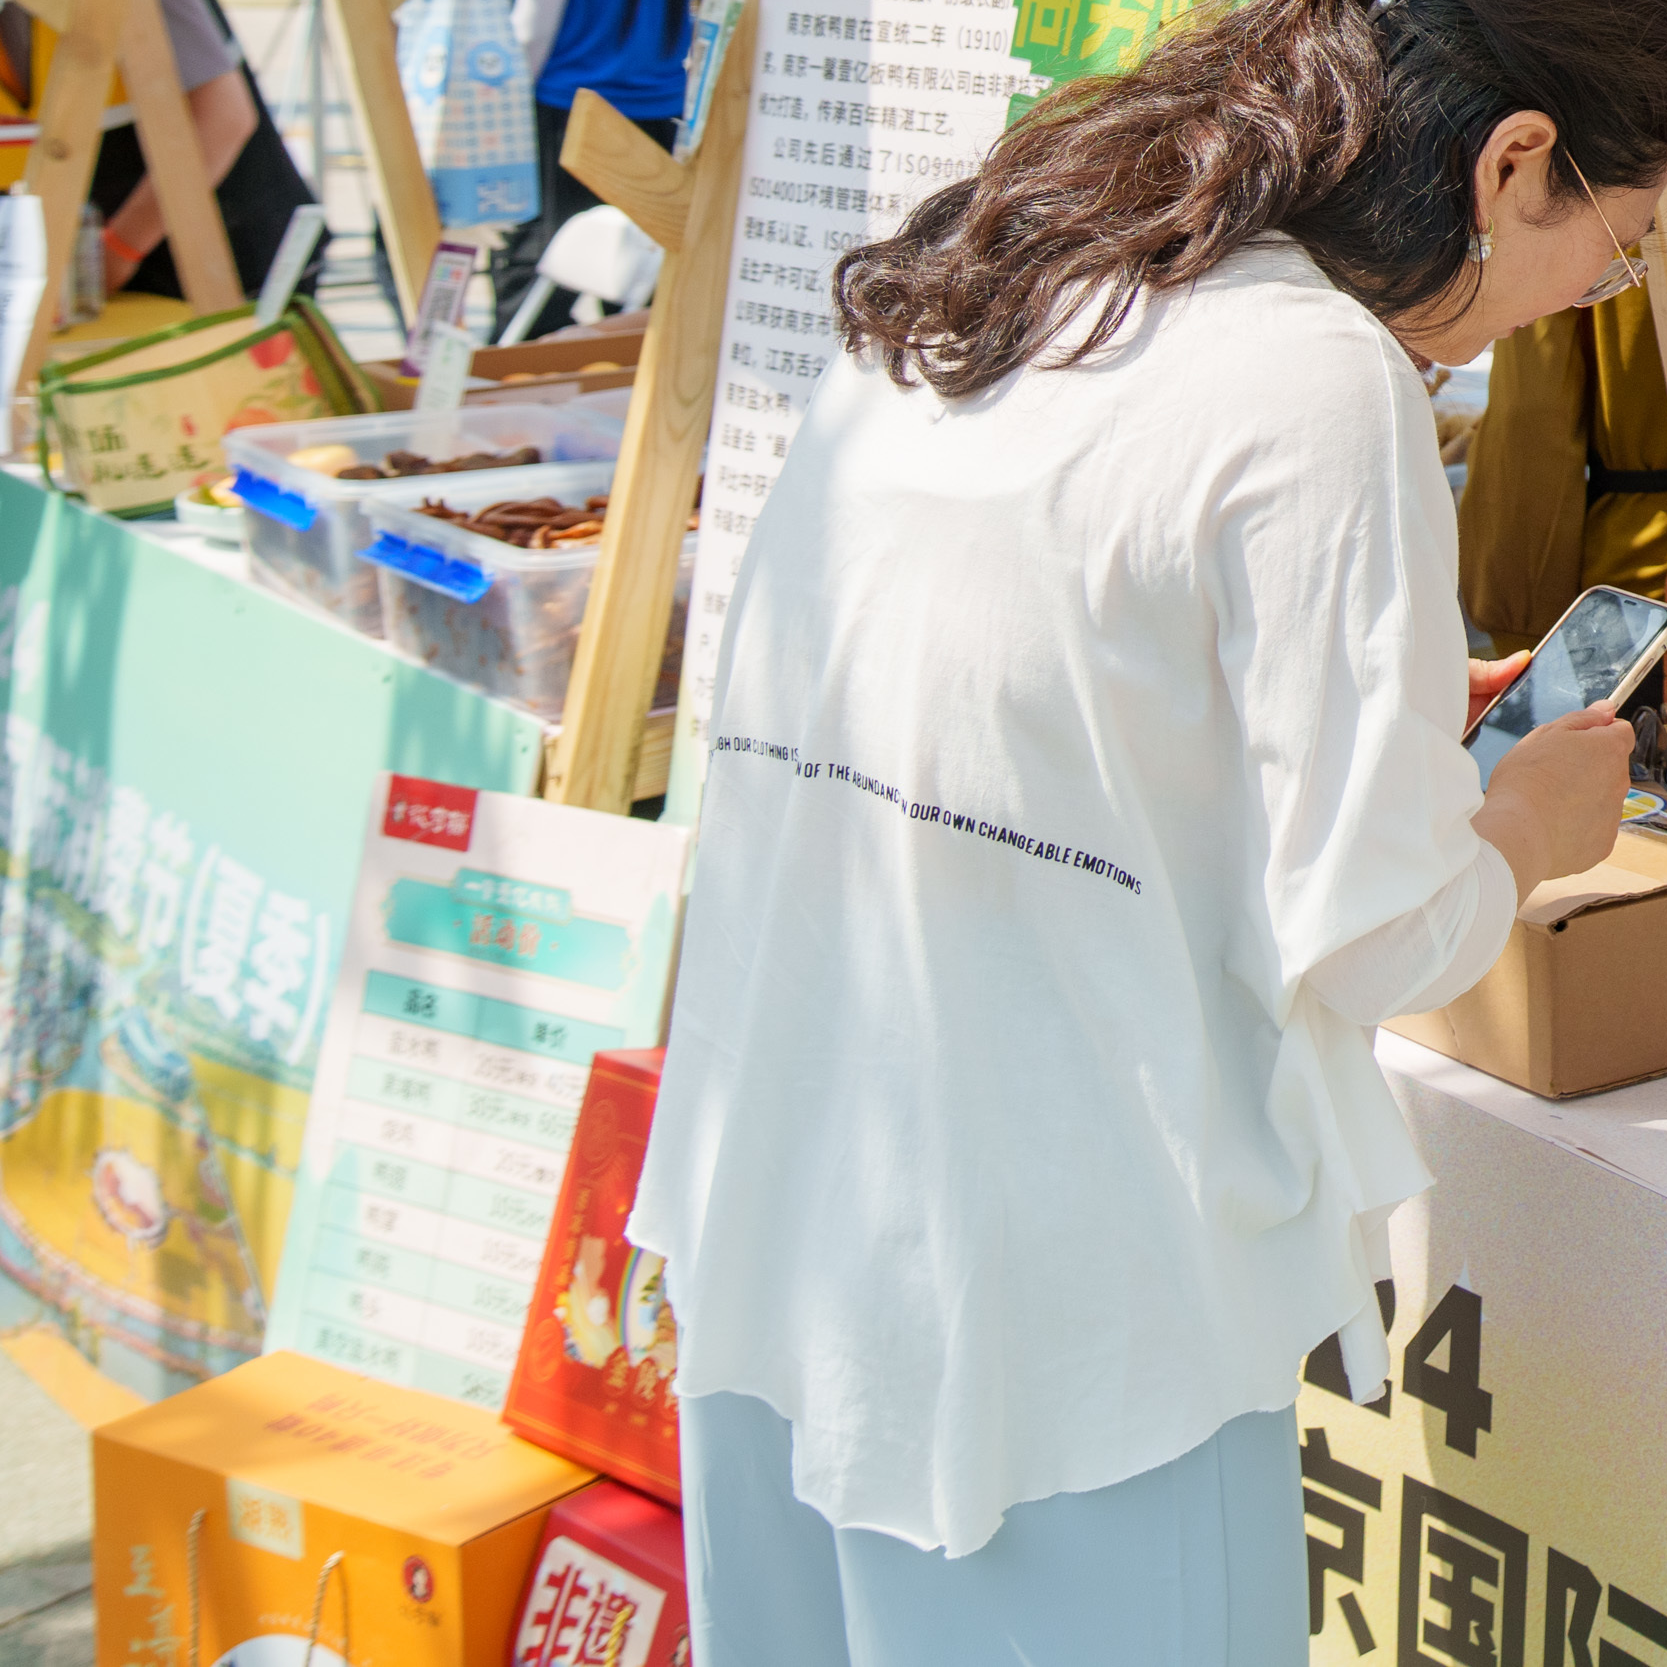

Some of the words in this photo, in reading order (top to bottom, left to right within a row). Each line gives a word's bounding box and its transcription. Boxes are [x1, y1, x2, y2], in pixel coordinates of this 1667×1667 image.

[828, 763, 850, 782] THE
[910, 802, 939, 823] OUR
[943, 810, 976, 834] OWN
[978, 821, 1070, 865] CHANGEABLE
[1073, 850, 1142, 896] EMOTIONS
